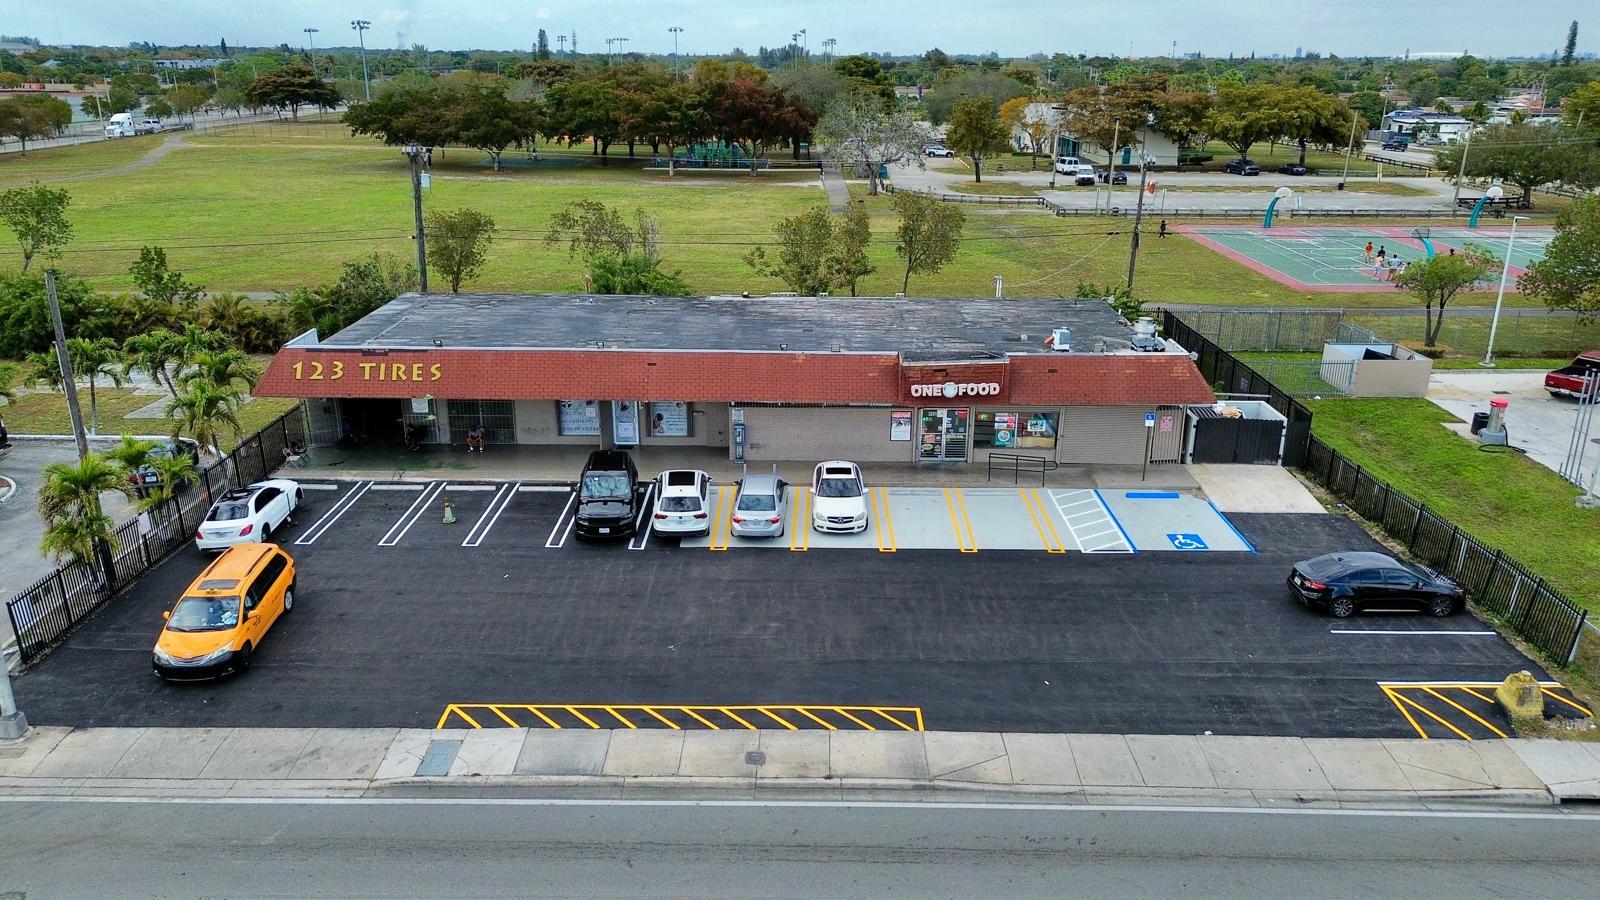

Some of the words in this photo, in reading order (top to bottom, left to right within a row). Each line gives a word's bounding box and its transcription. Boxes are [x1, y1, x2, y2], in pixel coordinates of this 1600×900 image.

[292, 360, 344, 380] 123
[359, 362, 442, 381] TIRES
[910, 384, 942, 397] ONE
[958, 382, 1000, 396] FOOD
